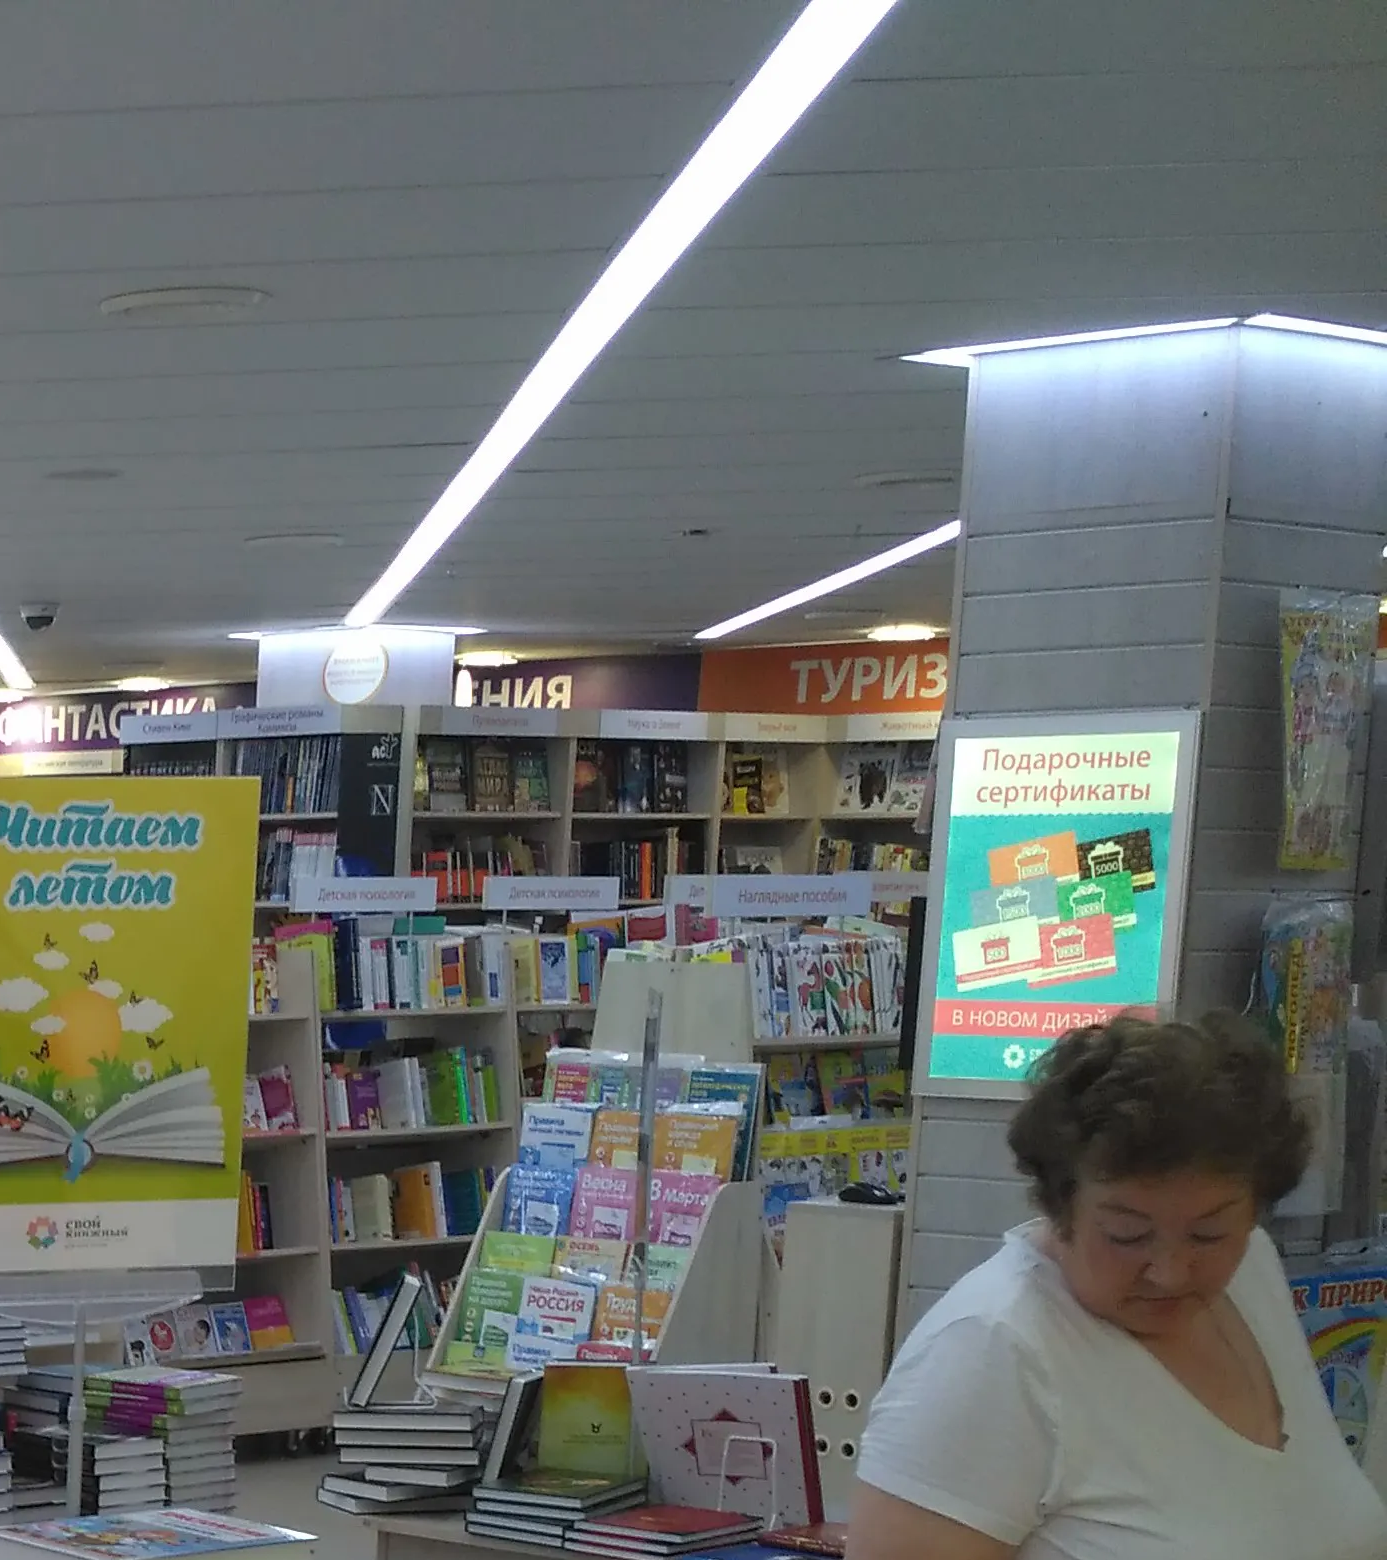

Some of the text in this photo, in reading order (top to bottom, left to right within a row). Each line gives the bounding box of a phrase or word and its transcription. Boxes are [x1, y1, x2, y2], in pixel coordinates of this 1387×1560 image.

[982, 748, 1151, 776] Подарочные
[976, 779, 1151, 808] сертификаты
[5, 859, 175, 909] летом
[738, 887, 847, 905] Наглядные пособия
[952, 1008, 1115, 1033] В НОВОМ дизай
[650, 1178, 663, 1201] 8
[65, 1215, 101, 1229] СВОЙ
[65, 1227, 129, 1238] КНИЖНЫЙ
[526, 1295, 586, 1313] РОССИЯ
